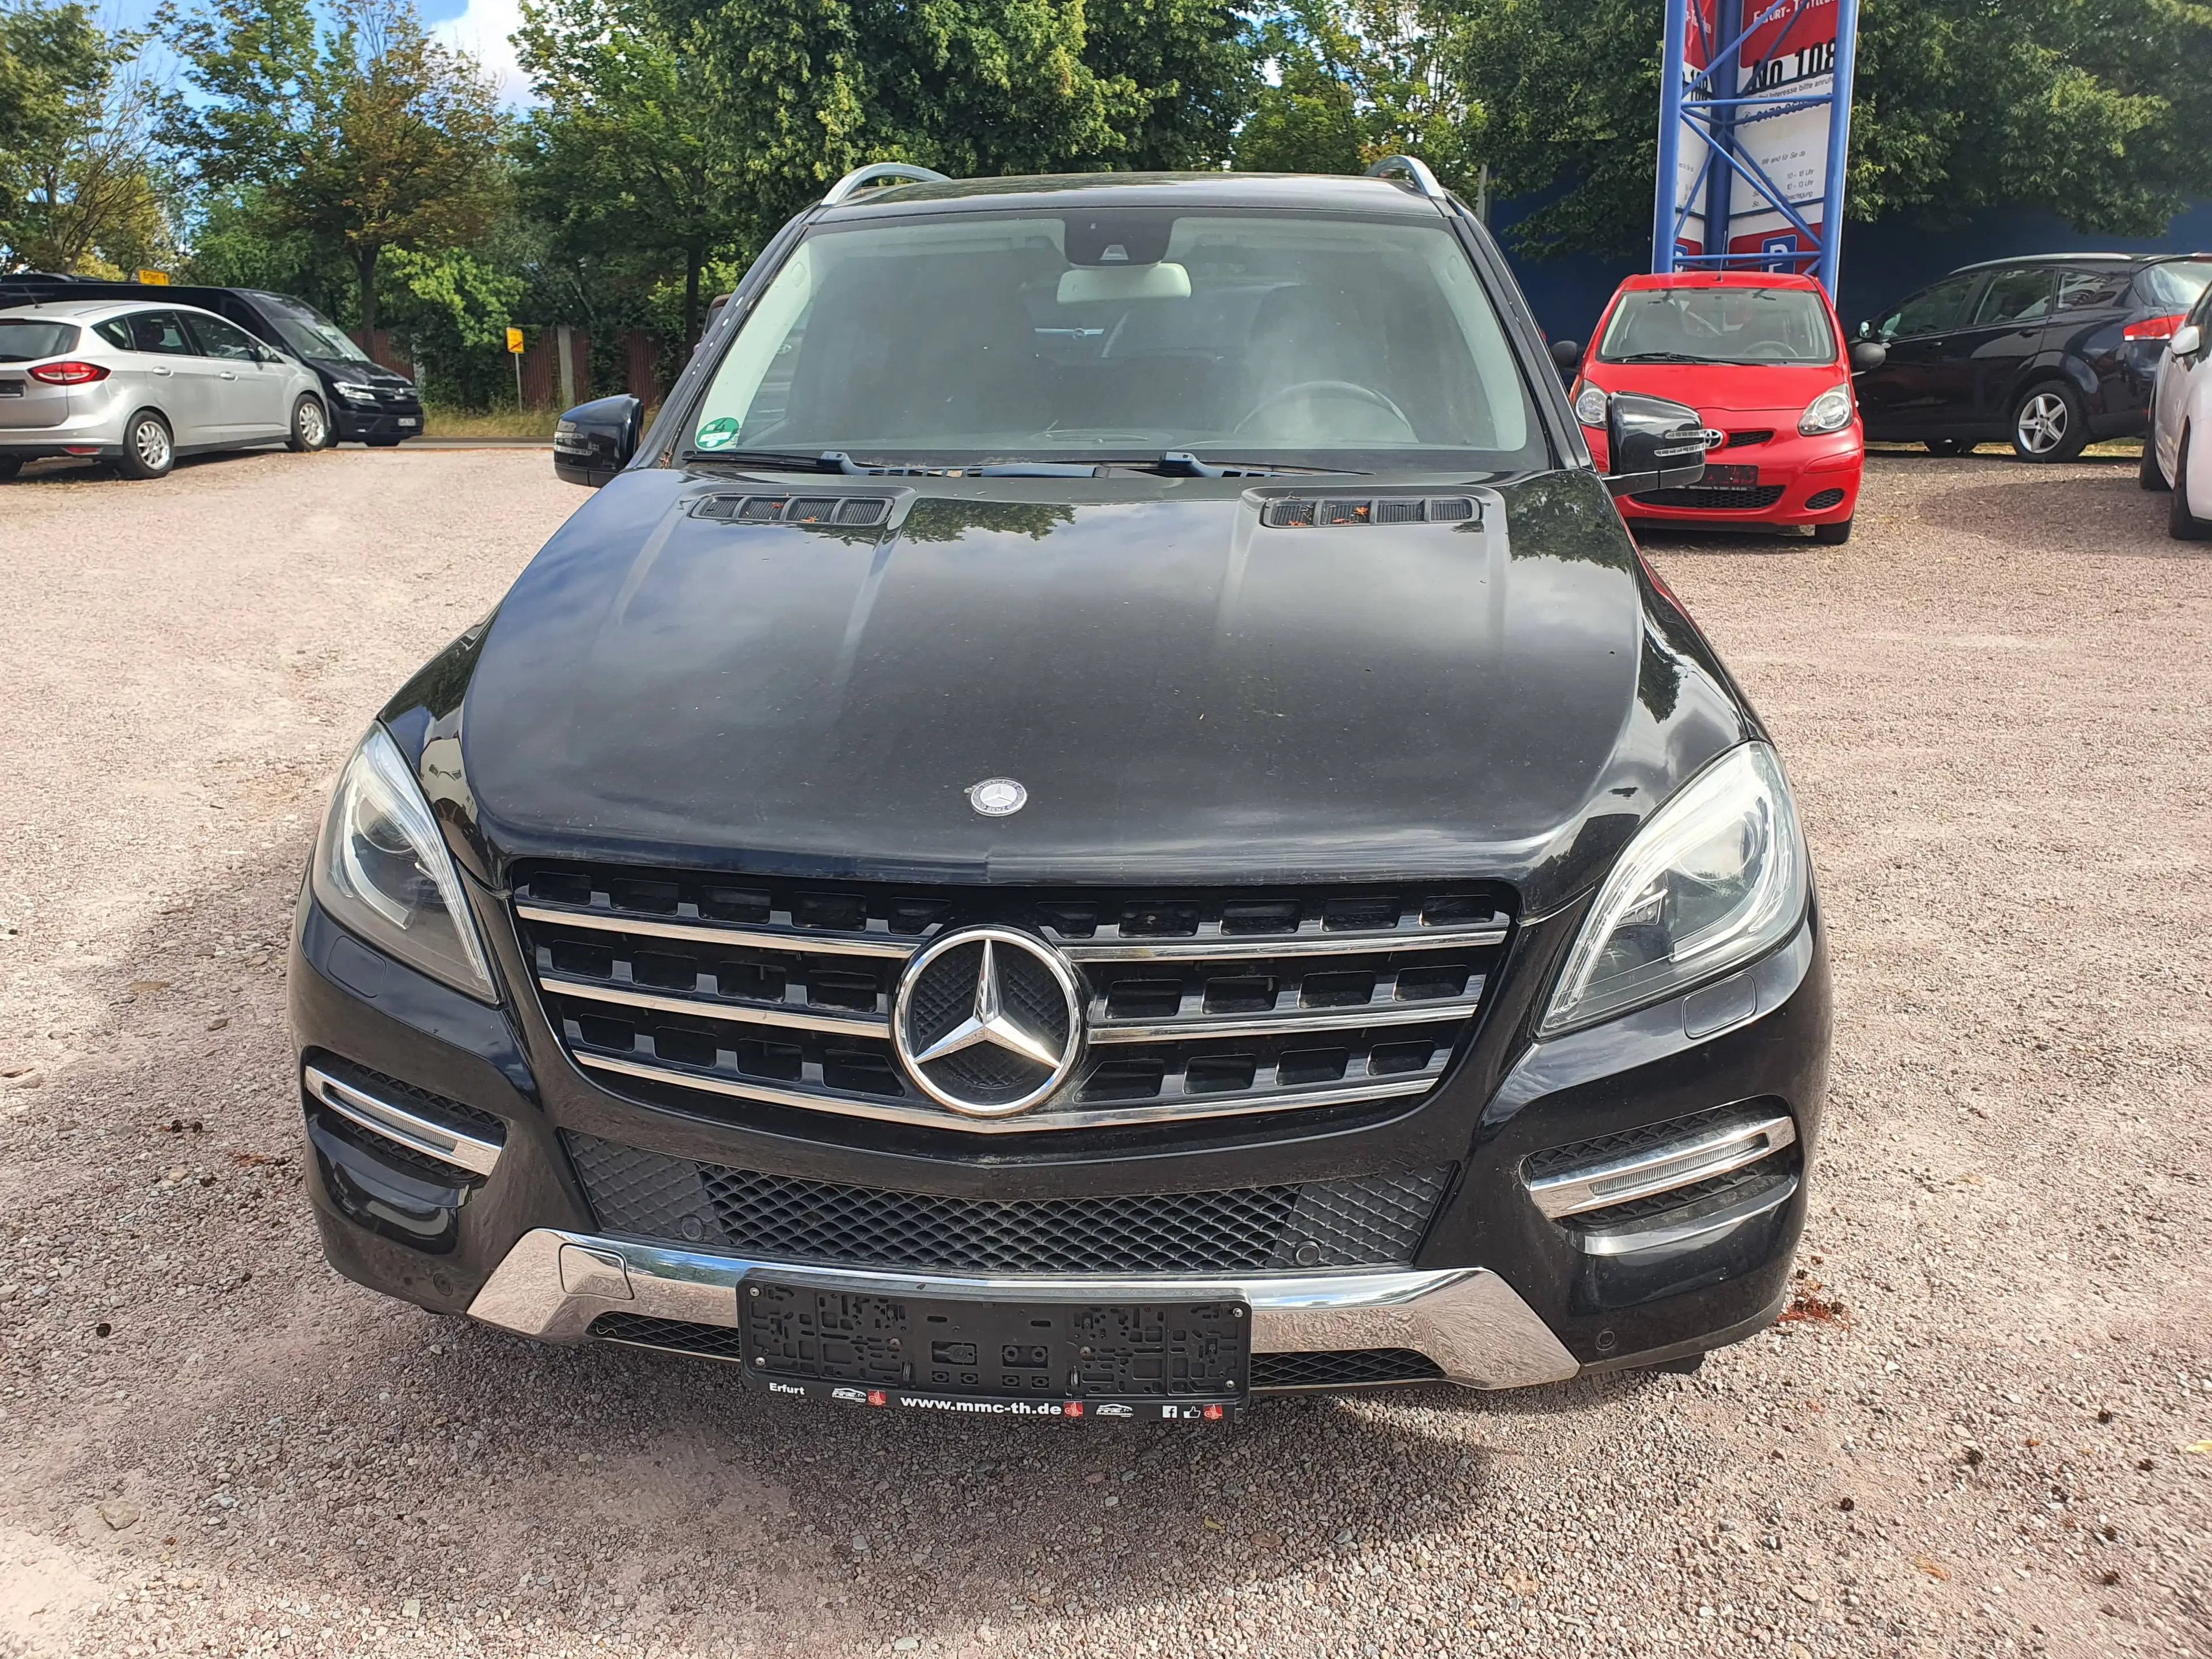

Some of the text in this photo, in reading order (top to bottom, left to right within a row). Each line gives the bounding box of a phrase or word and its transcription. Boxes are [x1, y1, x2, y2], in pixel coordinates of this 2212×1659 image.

[1794, 36, 1836, 77] 108
[1770, 86, 1797, 97] Interesse
[1799, 82, 1813, 92] bitte
[769, 1382, 805, 1395] Erfurt
[900, 1397, 1062, 1415] www.mmc-th.de
